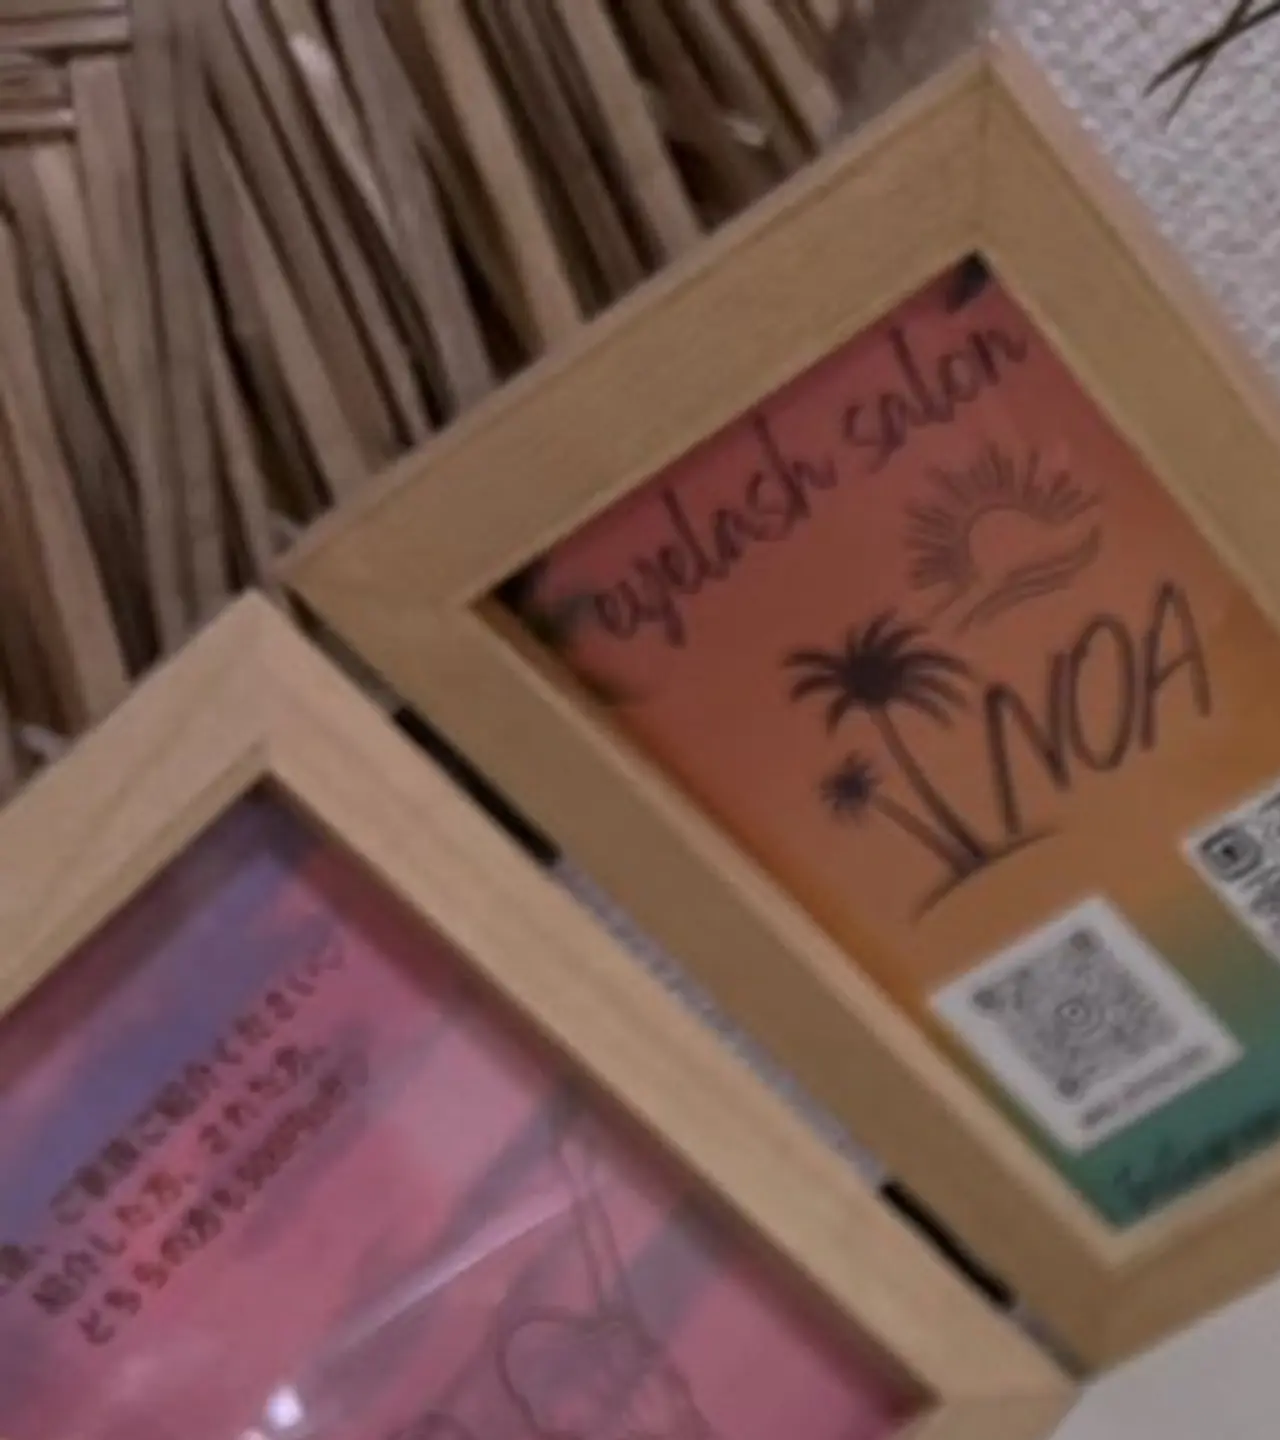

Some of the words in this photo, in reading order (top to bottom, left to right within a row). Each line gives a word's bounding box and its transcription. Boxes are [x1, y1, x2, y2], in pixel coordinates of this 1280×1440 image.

[594, 411, 838, 650] eyelash
[844, 325, 1029, 473] salon
[982, 579, 1211, 834] NOA
